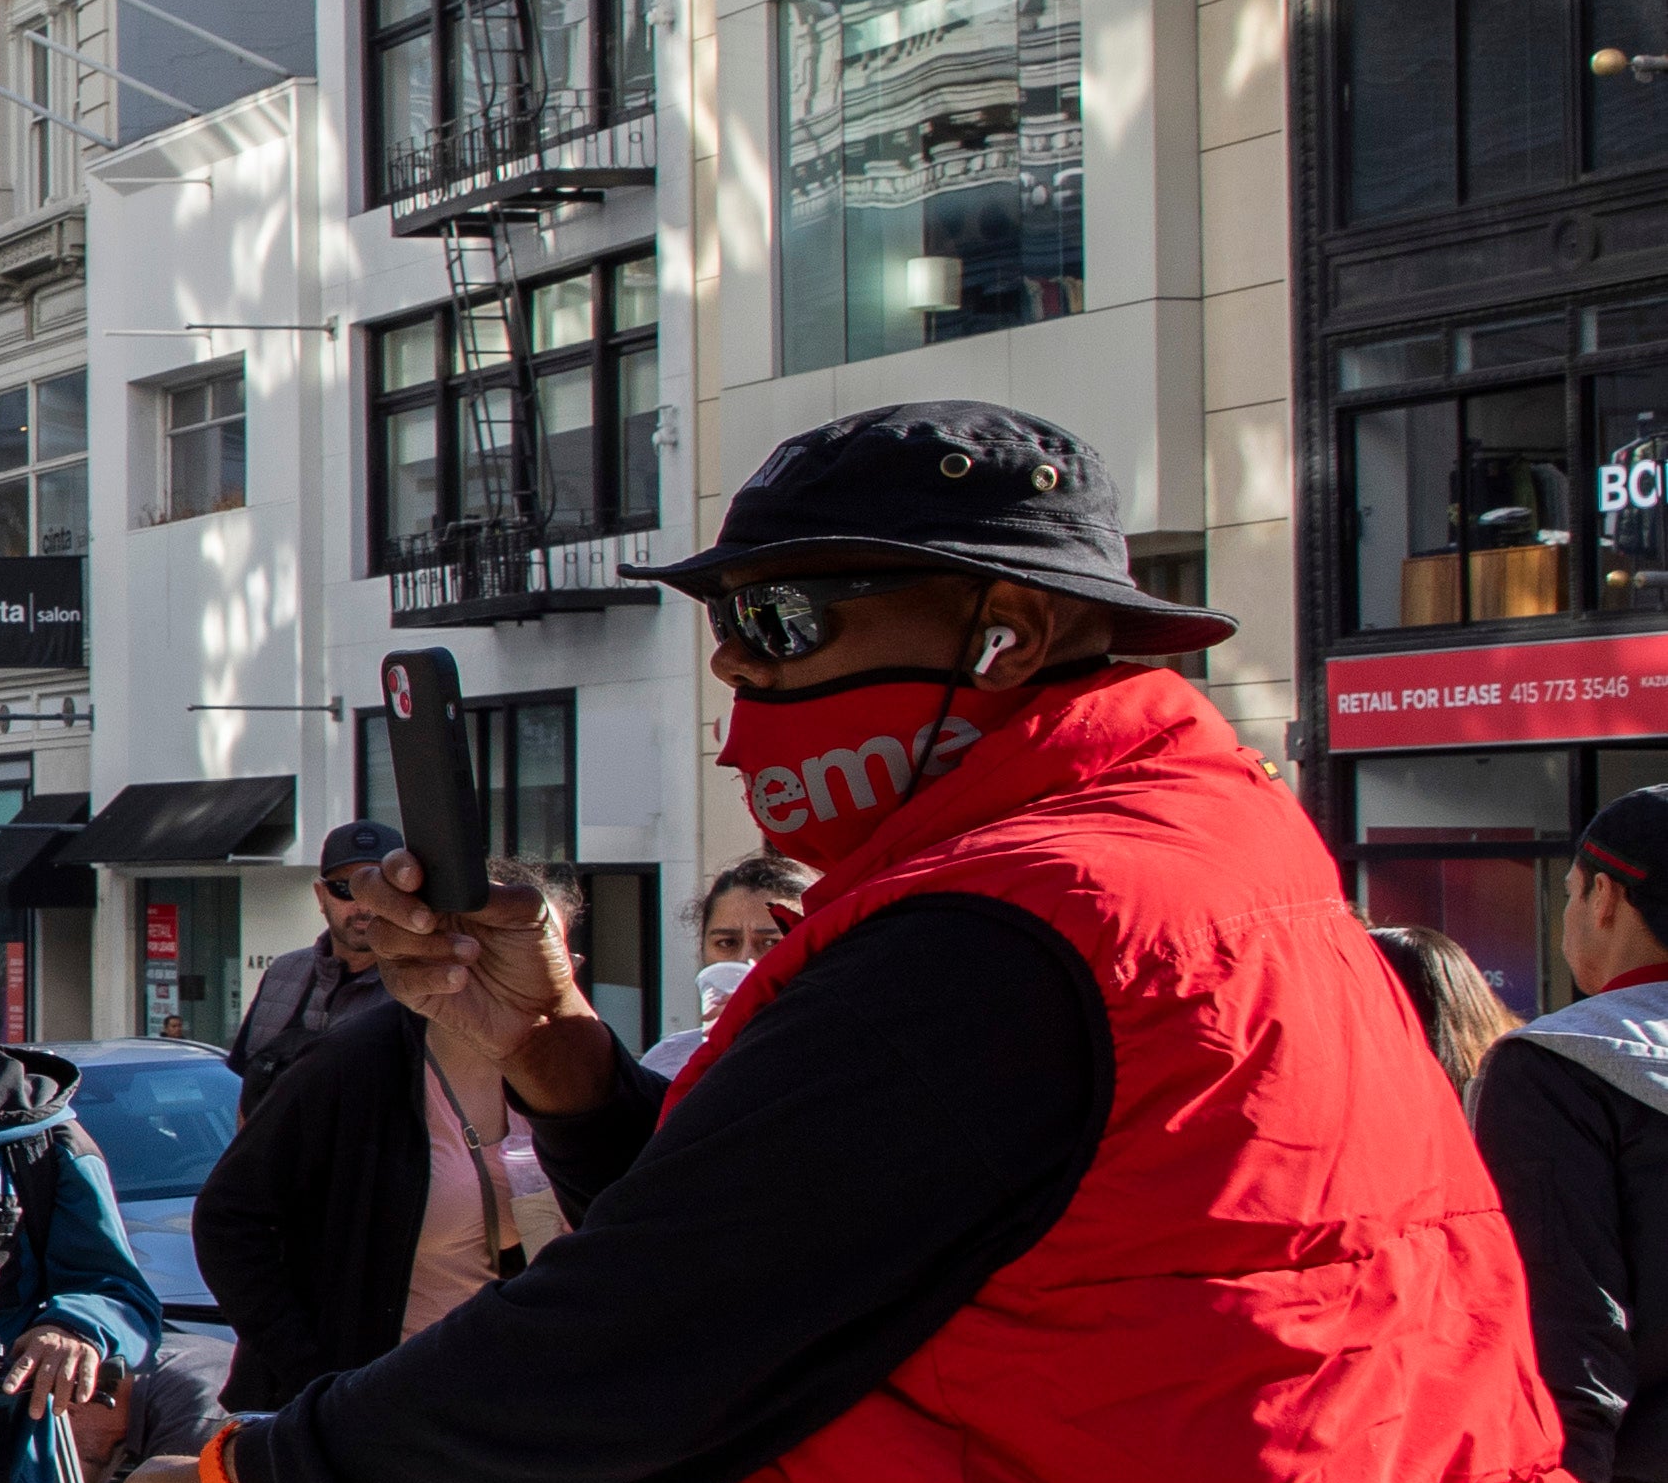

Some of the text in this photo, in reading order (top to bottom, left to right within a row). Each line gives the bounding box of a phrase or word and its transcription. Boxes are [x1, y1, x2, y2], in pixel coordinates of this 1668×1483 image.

[37, 605, 81, 623] salon
[1337, 690, 1398, 714] RETAIL
[1402, 687, 1439, 710] FOR
[1443, 683, 1501, 708] LEASE
[1509, 682, 1539, 704] 415
[1544, 678, 1577, 702] 773
[1581, 675, 1630, 699] 3546
[743, 716, 983, 834] eme
